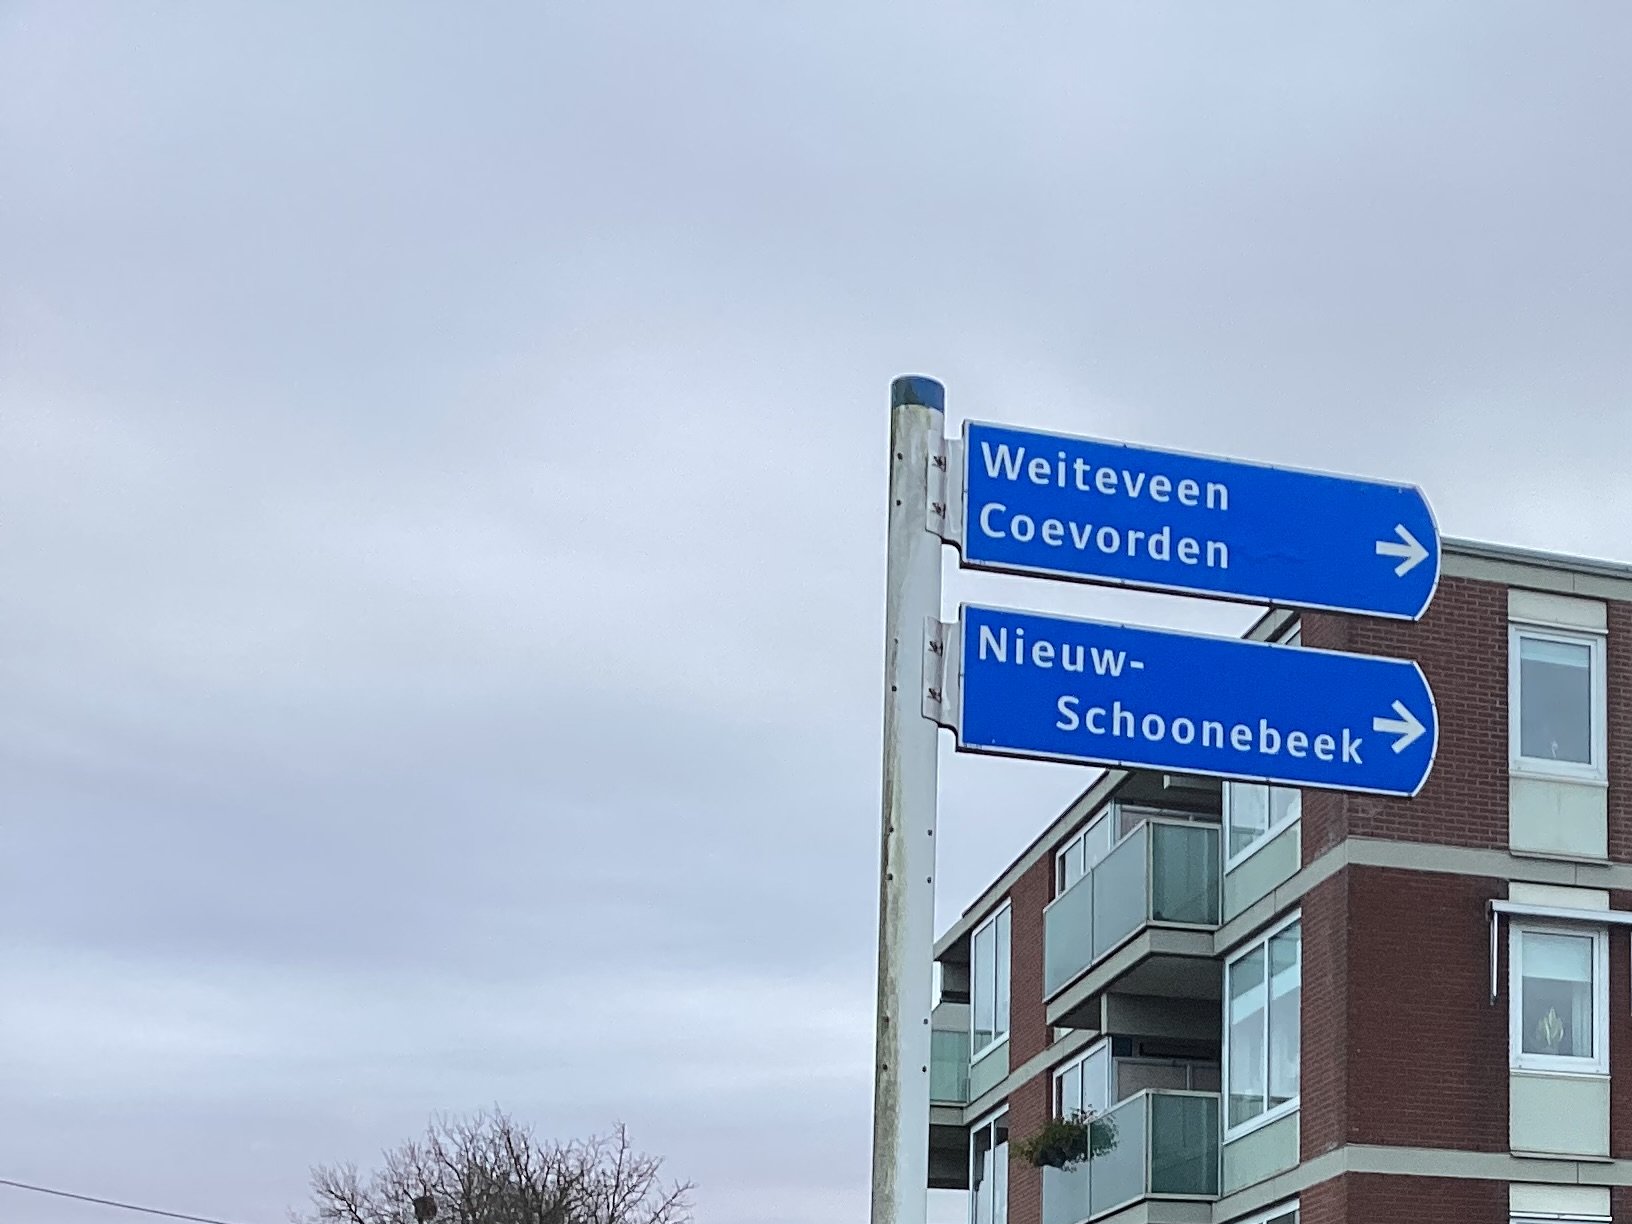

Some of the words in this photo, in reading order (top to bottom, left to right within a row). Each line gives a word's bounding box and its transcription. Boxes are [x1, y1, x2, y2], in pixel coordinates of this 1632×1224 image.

[981, 441, 1229, 511] Weiteveen
[980, 503, 1229, 569] Coevorden
[979, 625, 1145, 678] Nieuw-
[1056, 695, 1364, 765] Schoonebeek
